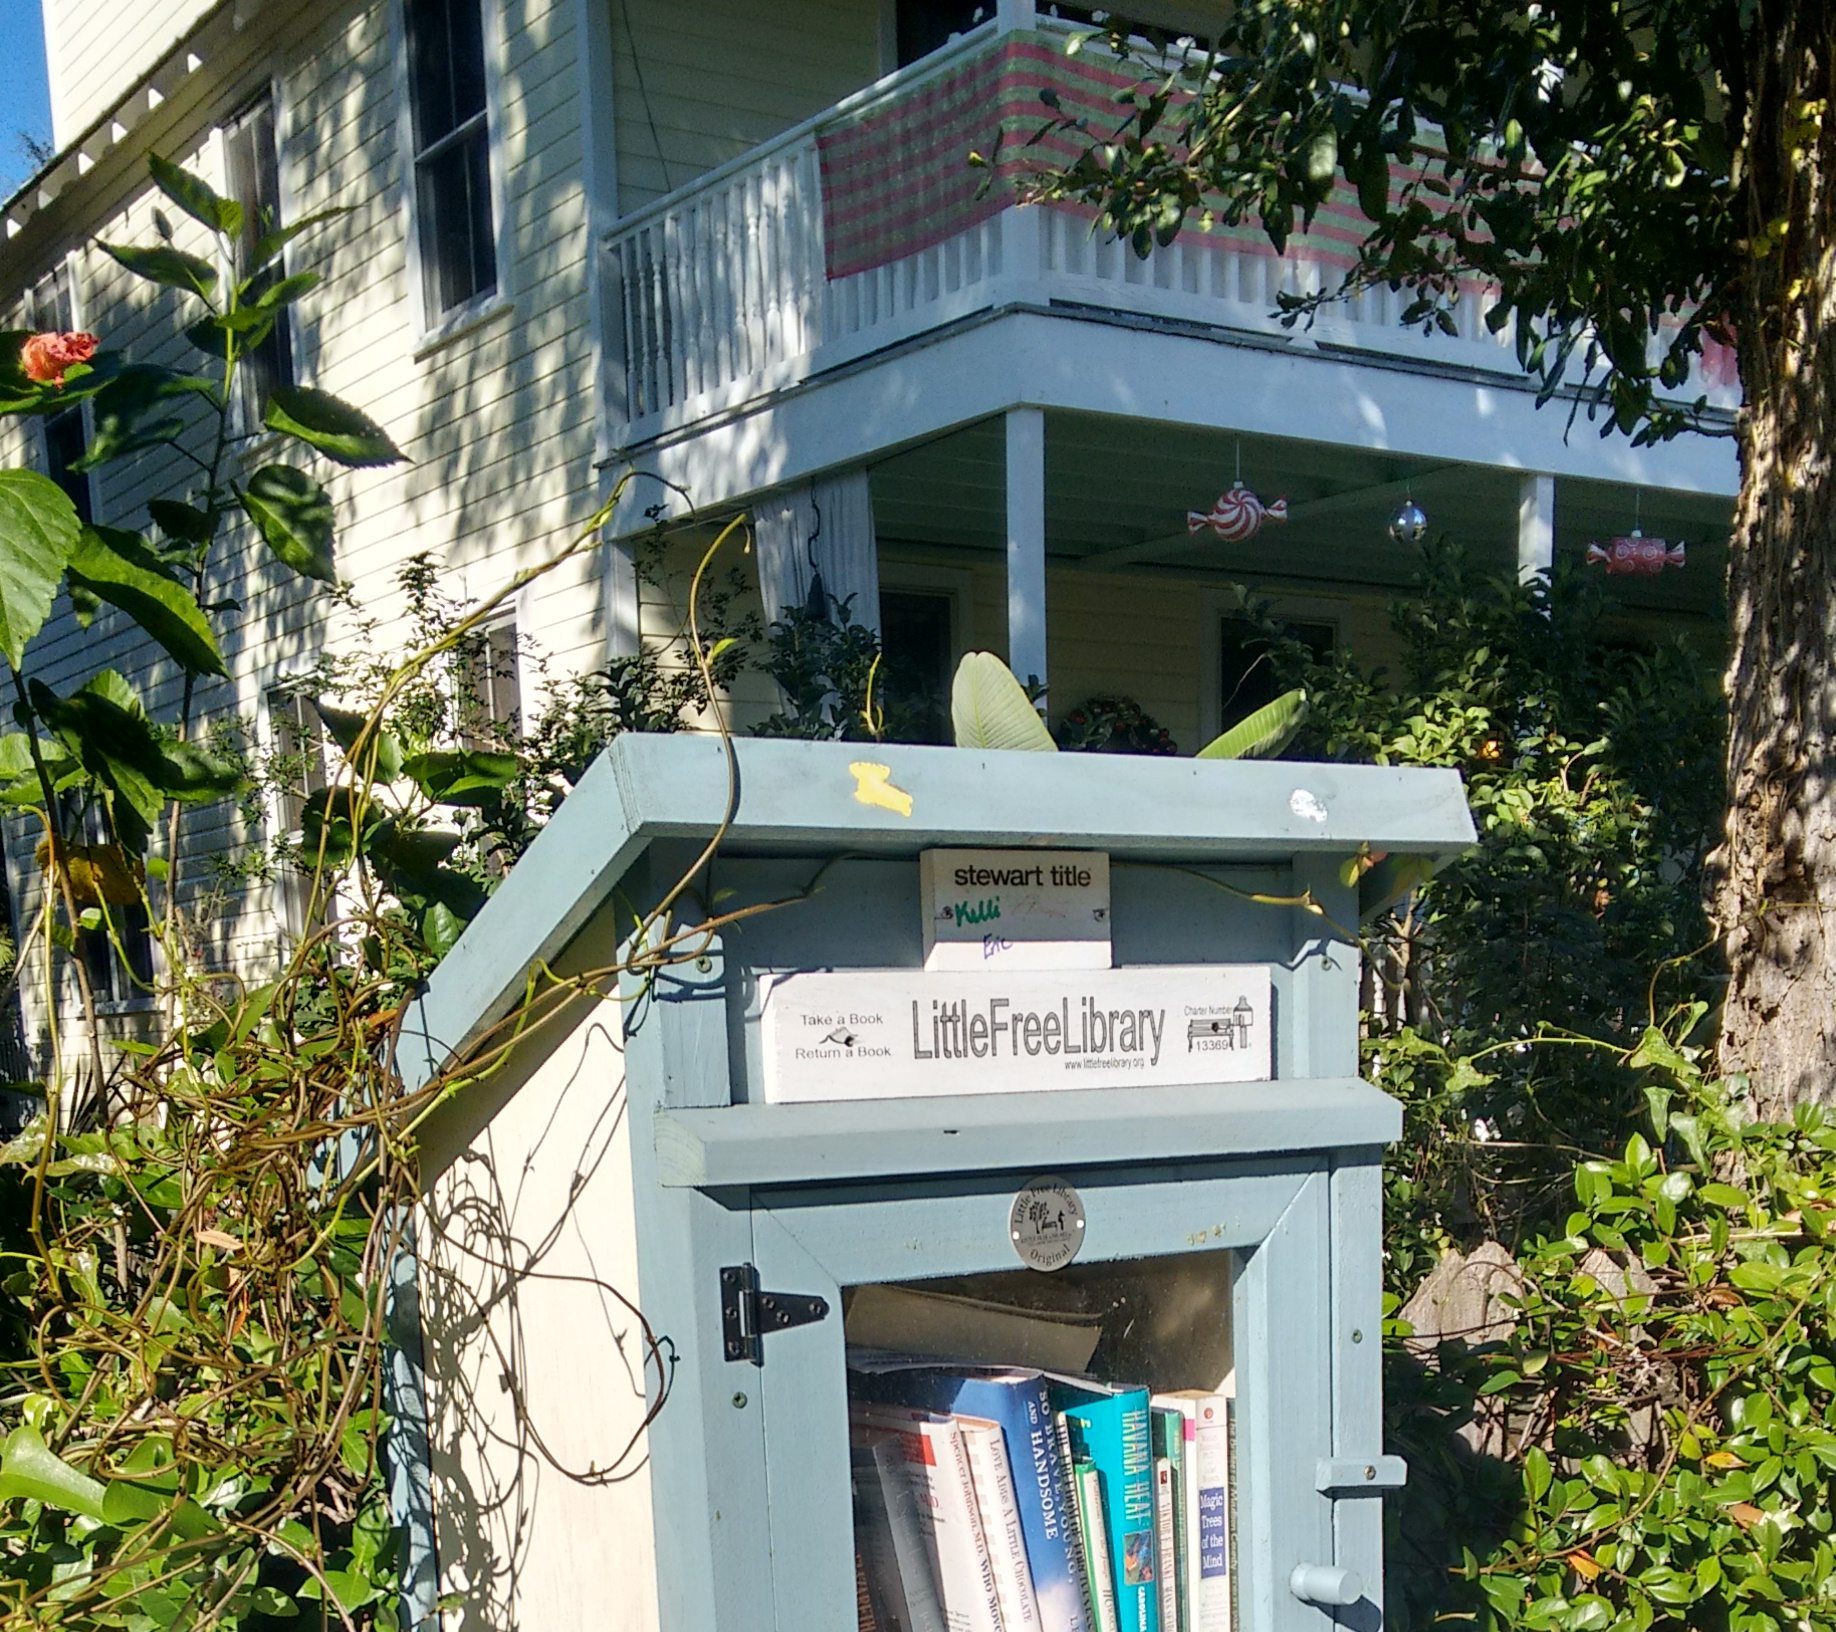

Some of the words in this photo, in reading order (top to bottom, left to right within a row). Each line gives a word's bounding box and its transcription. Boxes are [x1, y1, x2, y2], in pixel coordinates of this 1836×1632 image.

[954, 864, 1044, 886] stewart
[1050, 865, 1091, 887] title
[954, 896, 1001, 927] Kelli
[801, 1013, 833, 1026] Take
[837, 1016, 845, 1025] a
[850, 1013, 883, 1025] Book
[1184, 1005, 1207, 1016] Charter
[1208, 1004, 1233, 1016] Number
[912, 996, 1166, 1066] LittleFreeLibrary
[795, 1047, 841, 1060] Return
[846, 1049, 854, 1058] a
[858, 1046, 891, 1058] Book
[1196, 1039, 1228, 1052] 13369
[1030, 1243, 1071, 1267] Original
[1028, 1401, 1038, 1425] AND
[1039, 1391, 1050, 1415] SO
[1122, 1407, 1150, 1476] HAVANA
[1031, 1430, 1059, 1540] HANDSOME
[1124, 1481, 1151, 1523] HEAT
[1200, 1493, 1223, 1510] Magic
[1201, 1515, 1222, 1529] Trees
[1202, 1536, 1209, 1547] of
[1209, 1534, 1223, 1547] the
[1003, 1507, 1014, 1518] A
[1013, 1560, 1033, 1623] CHOCOLATE
[1203, 1554, 1223, 1569] Mind
[980, 1558, 993, 1593] Who
[1138, 1585, 1148, 1632] CAROLINA
